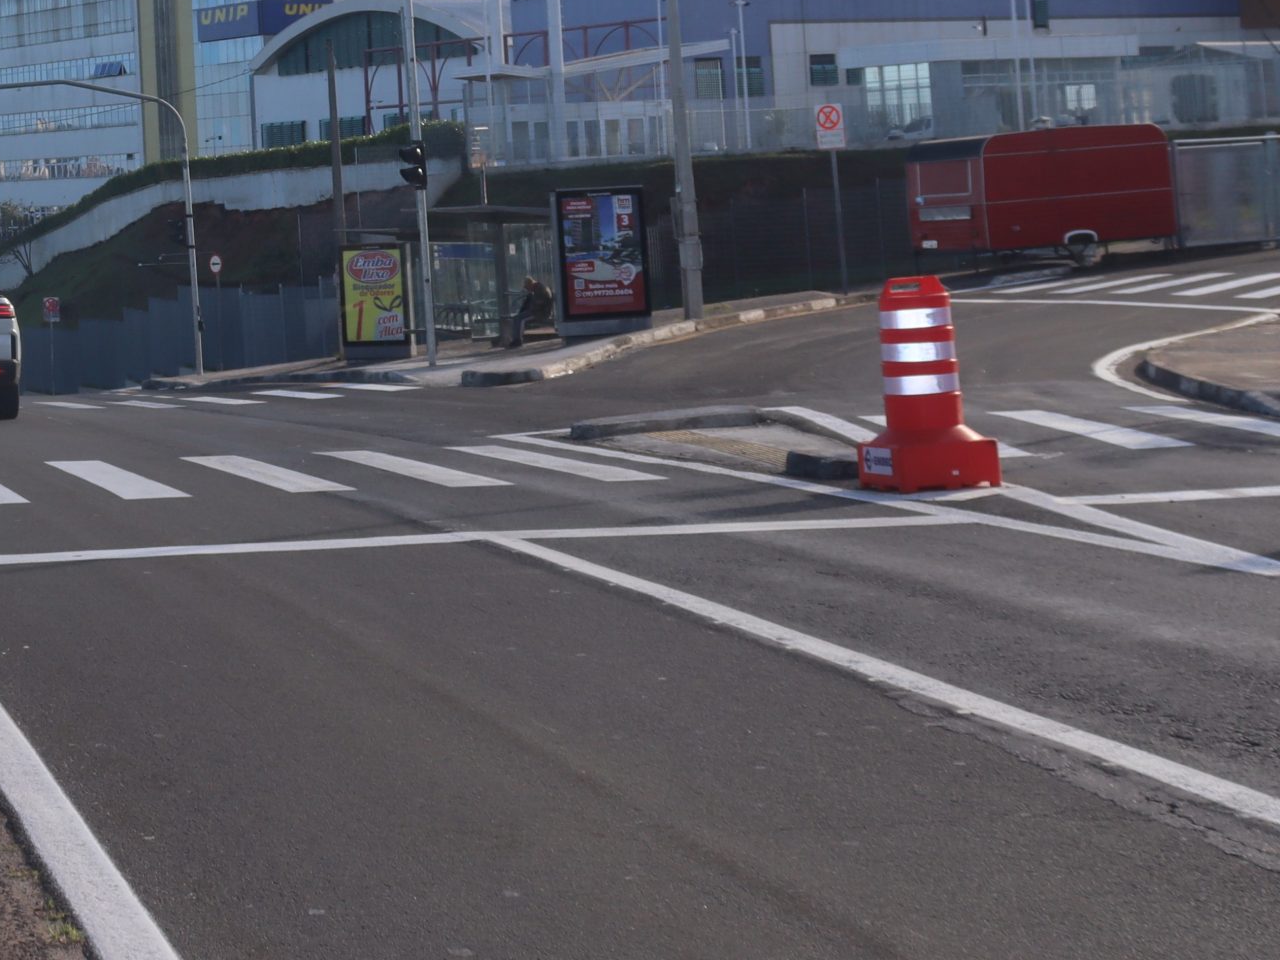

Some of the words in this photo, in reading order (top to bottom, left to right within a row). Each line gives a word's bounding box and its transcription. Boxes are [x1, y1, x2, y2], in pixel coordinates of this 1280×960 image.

[201, 4, 249, 25] UNIP
[621, 214, 629, 226] 3
[353, 256, 393, 268] Emba
[361, 268, 389, 280] Lixo
[352, 300, 368, 340] 1
[378, 314, 398, 325] com
